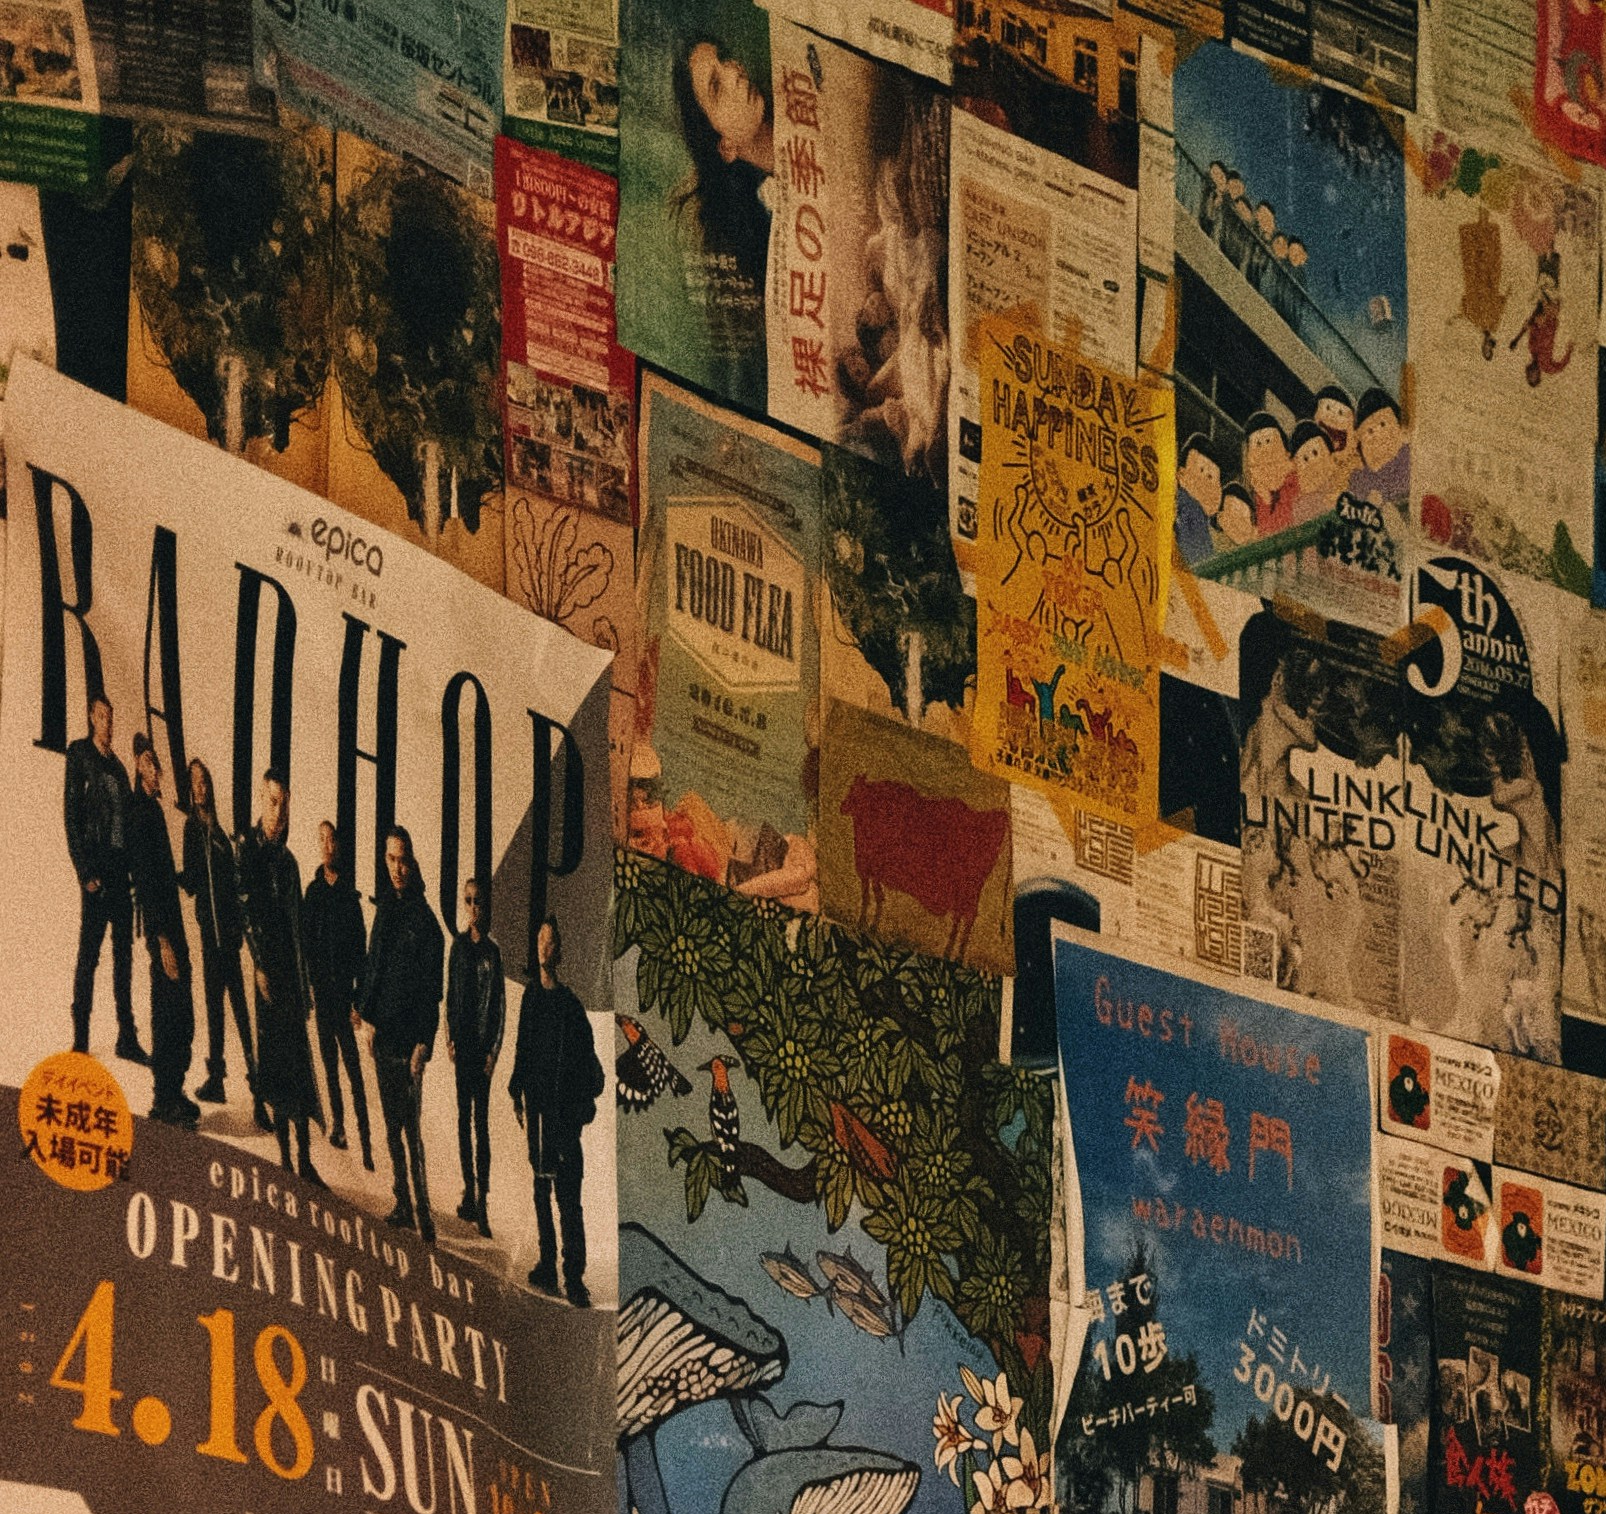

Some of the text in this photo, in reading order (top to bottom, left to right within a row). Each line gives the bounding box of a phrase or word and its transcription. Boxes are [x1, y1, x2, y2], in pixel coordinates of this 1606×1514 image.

[1011, 335, 1138, 426] SUNDAY
[993, 380, 1159, 493] HAPPINESS
[311, 516, 384, 578] epica
[674, 542, 794, 662] FOOD FLEA
[1244, 794, 1563, 915] UNITED UNITED
[1308, 767, 1502, 853] LINK LINK
[1094, 975, 1323, 1086] Guest House
[34, 1095, 119, 1140] 未成年
[1434, 1067, 1494, 1099] MEXICO
[20, 1137, 131, 1182] 入場可能
[209, 1158, 476, 1305] epica rooftop bar
[1383, 1201, 1438, 1231] MEXICO
[1545, 1212, 1601, 1242] MEXICO
[126, 1192, 508, 1403] OPENING PARTY
[49, 1280, 316, 1481] 4.18
[1094, 1320, 1169, 1382] 10歩
[1233, 1343, 1348, 1474] 3000円
